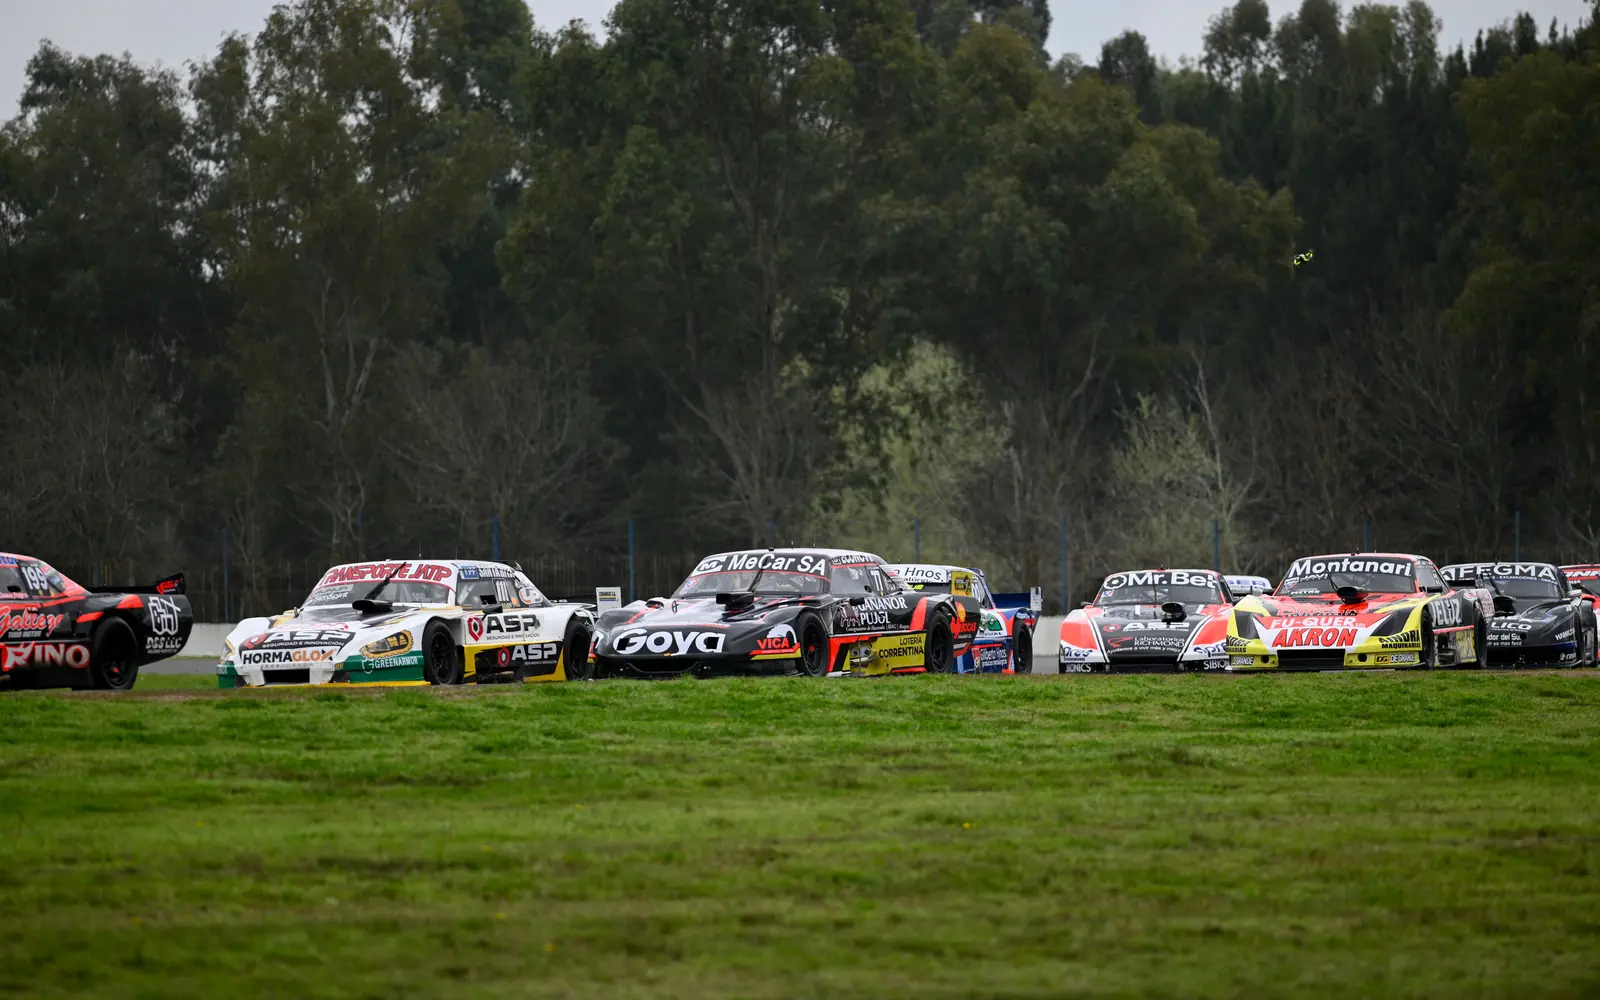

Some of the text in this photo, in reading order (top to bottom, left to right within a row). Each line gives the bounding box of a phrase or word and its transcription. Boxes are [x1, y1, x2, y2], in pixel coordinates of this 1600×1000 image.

[727, 553, 826, 576] MeCar SA
[1288, 558, 1411, 578] Montanari
[22, 566, 48, 590] 199
[904, 567, 945, 583] Hnos.
[1459, 564, 1556, 580] FEGMA
[1127, 572, 1168, 587] Mr.
[486, 614, 537, 634] ASP
[1270, 617, 1356, 629] FU-QUER
[264, 630, 350, 644] ASP
[613, 628, 726, 656] Goya
[756, 637, 790, 650] VICA
[899, 635, 922, 646] LOTERÍA
[1271, 627, 1358, 648] AKRON
[1500, 633, 1511, 641] del
[1511, 633, 1521, 641] Su
[262, 641, 299, 649] SEGURIDAD
[511, 643, 557, 661] ASP
[878, 646, 924, 658] CORRENTINA
[1107, 646, 1133, 654] Ayudamos
[374, 656, 419, 669] GREENARMOR
[1390, 654, 1398, 663] DE
